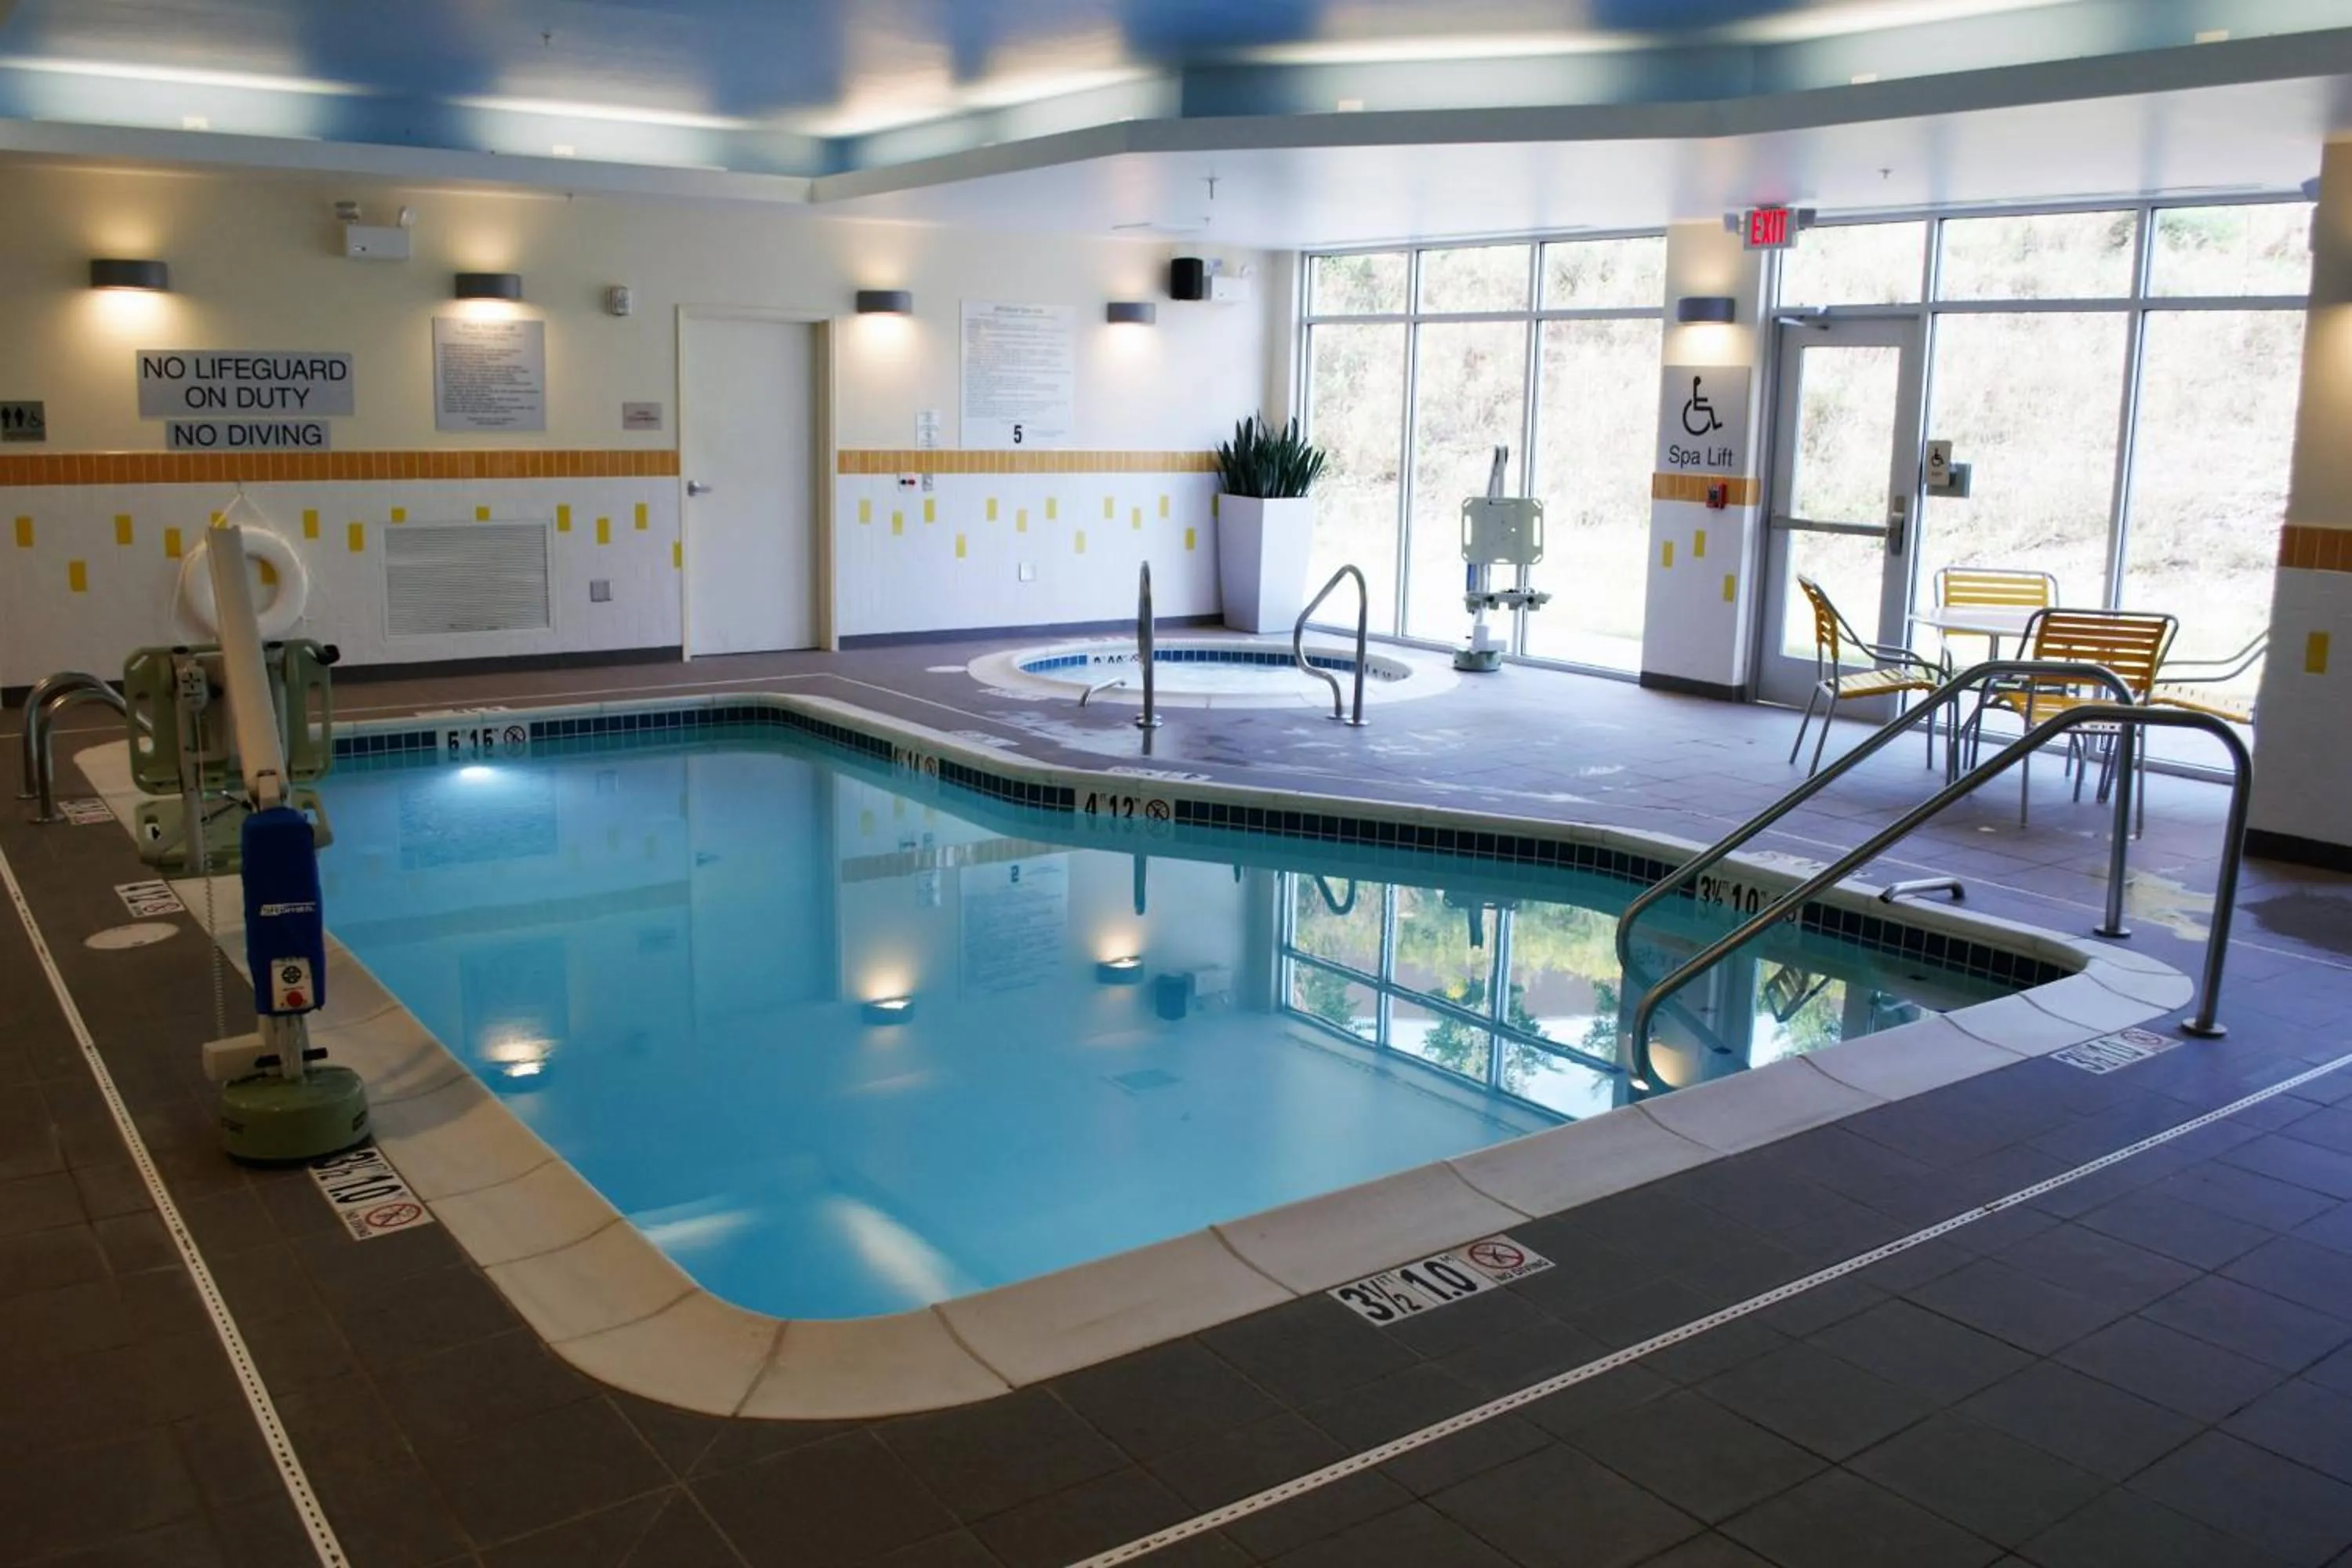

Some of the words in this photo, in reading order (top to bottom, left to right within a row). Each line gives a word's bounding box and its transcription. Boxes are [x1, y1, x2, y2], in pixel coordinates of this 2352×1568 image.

[1751, 209, 1788, 245] EXIT
[143, 357, 186, 379] NO
[196, 358, 347, 381] LIFEGUARD
[185, 387, 227, 408] ON
[237, 387, 310, 408] DUTY
[175, 424, 216, 446] NO
[229, 424, 321, 446] DIVING
[1014, 424, 1022, 444] 5
[1668, 445, 1700, 469] Spa
[1708, 446, 1732, 467] Lift
